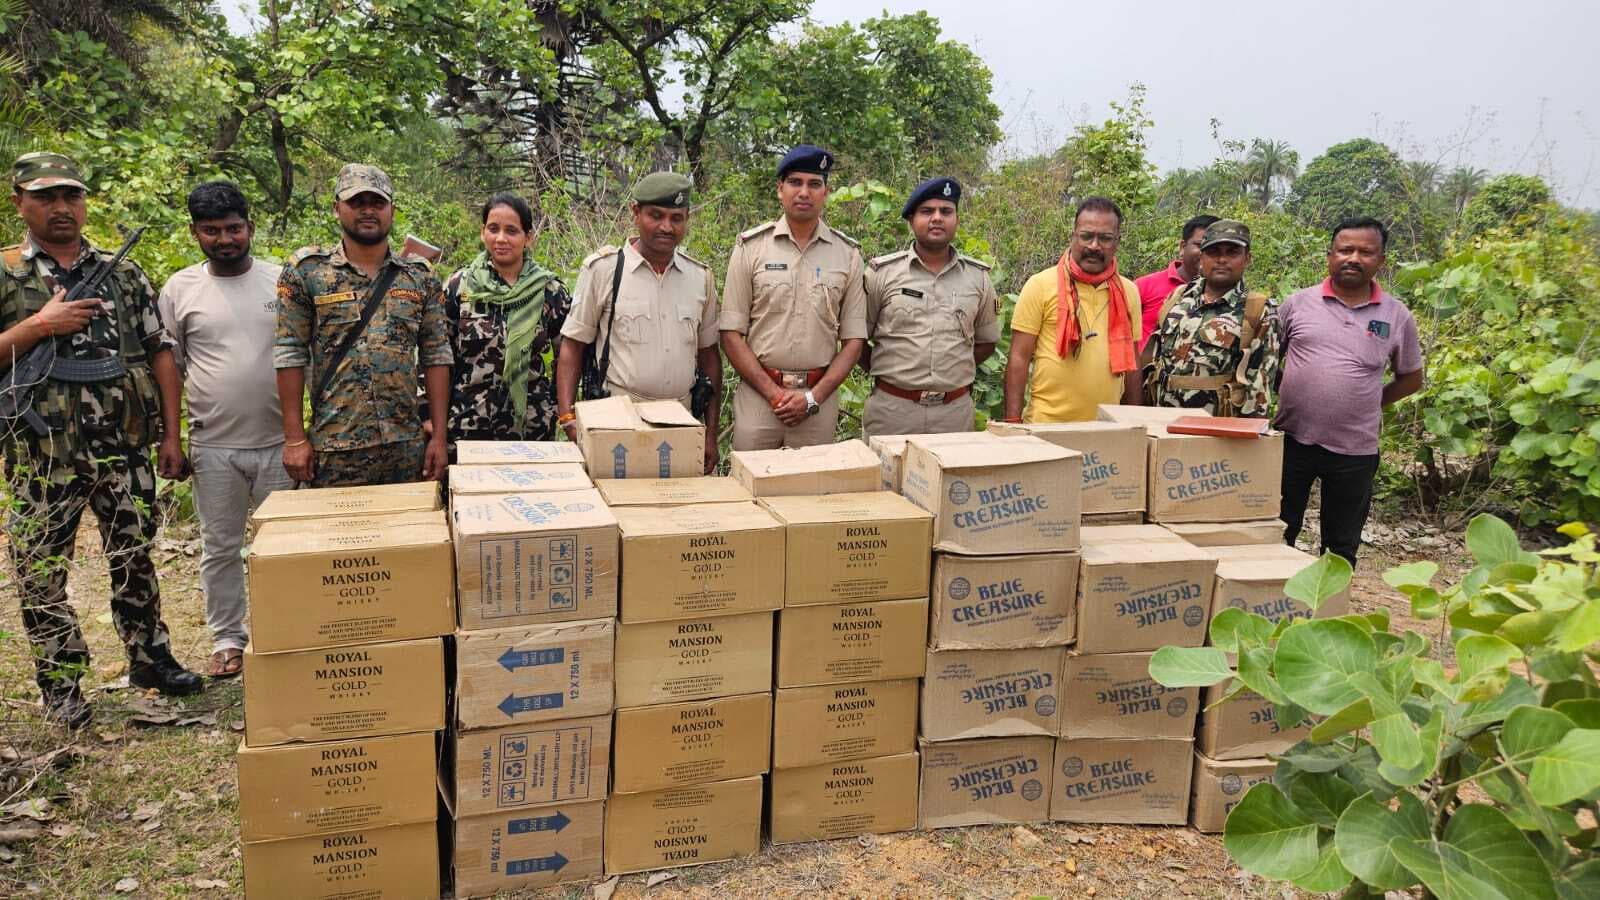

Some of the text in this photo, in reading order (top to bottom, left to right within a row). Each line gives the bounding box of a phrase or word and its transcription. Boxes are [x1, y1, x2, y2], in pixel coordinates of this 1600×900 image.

[1189, 459, 1232, 479] BLUE
[977, 482, 1024, 505] BLUE
[847, 527, 880, 536] ROYAL
[690, 536, 726, 547] ROYAL
[838, 540, 887, 551] MANSION
[681, 550, 735, 562] MANSION
[849, 553, 875, 561] GOLD
[333, 556, 380, 569] ROYAL
[694, 563, 721, 572] GOLD
[322, 571, 391, 585] MANSION
[340, 587, 375, 597] GOLD
[978, 578, 1024, 600] BLUE
[841, 608, 875, 618] ROYAL
[678, 623, 714, 634] ROYAL
[833, 620, 882, 631] MANSION
[669, 635, 722, 648] MANSION
[844, 633, 870, 641] GOLD
[326, 651, 372, 664] ROYAL
[681, 649, 709, 658] GOLD
[315, 666, 382, 680] MANSION
[332, 681, 367, 691] GOLD
[836, 688, 868, 699] ROYAL
[827, 699, 874, 712] MANSION
[681, 707, 716, 720] ROYAL
[838, 713, 863, 722] GOLD
[672, 720, 724, 734] MANSION
[684, 733, 711, 744] GOLD
[321, 746, 367, 760] ROYAL
[311, 760, 377, 776] MANSION
[832, 765, 867, 776] ROYAL
[1090, 758, 1133, 778] BLUE
[328, 776, 362, 787] GOLD
[825, 777, 874, 789] MANSION
[836, 790, 861, 798] GOLD
[668, 825, 695, 834] GOLD
[324, 835, 367, 848] ROYAL
[654, 834, 707, 848] MANSION
[313, 848, 378, 864] MANSION
[663, 849, 698, 860] ROYAL
[329, 863, 362, 874] GOLD
